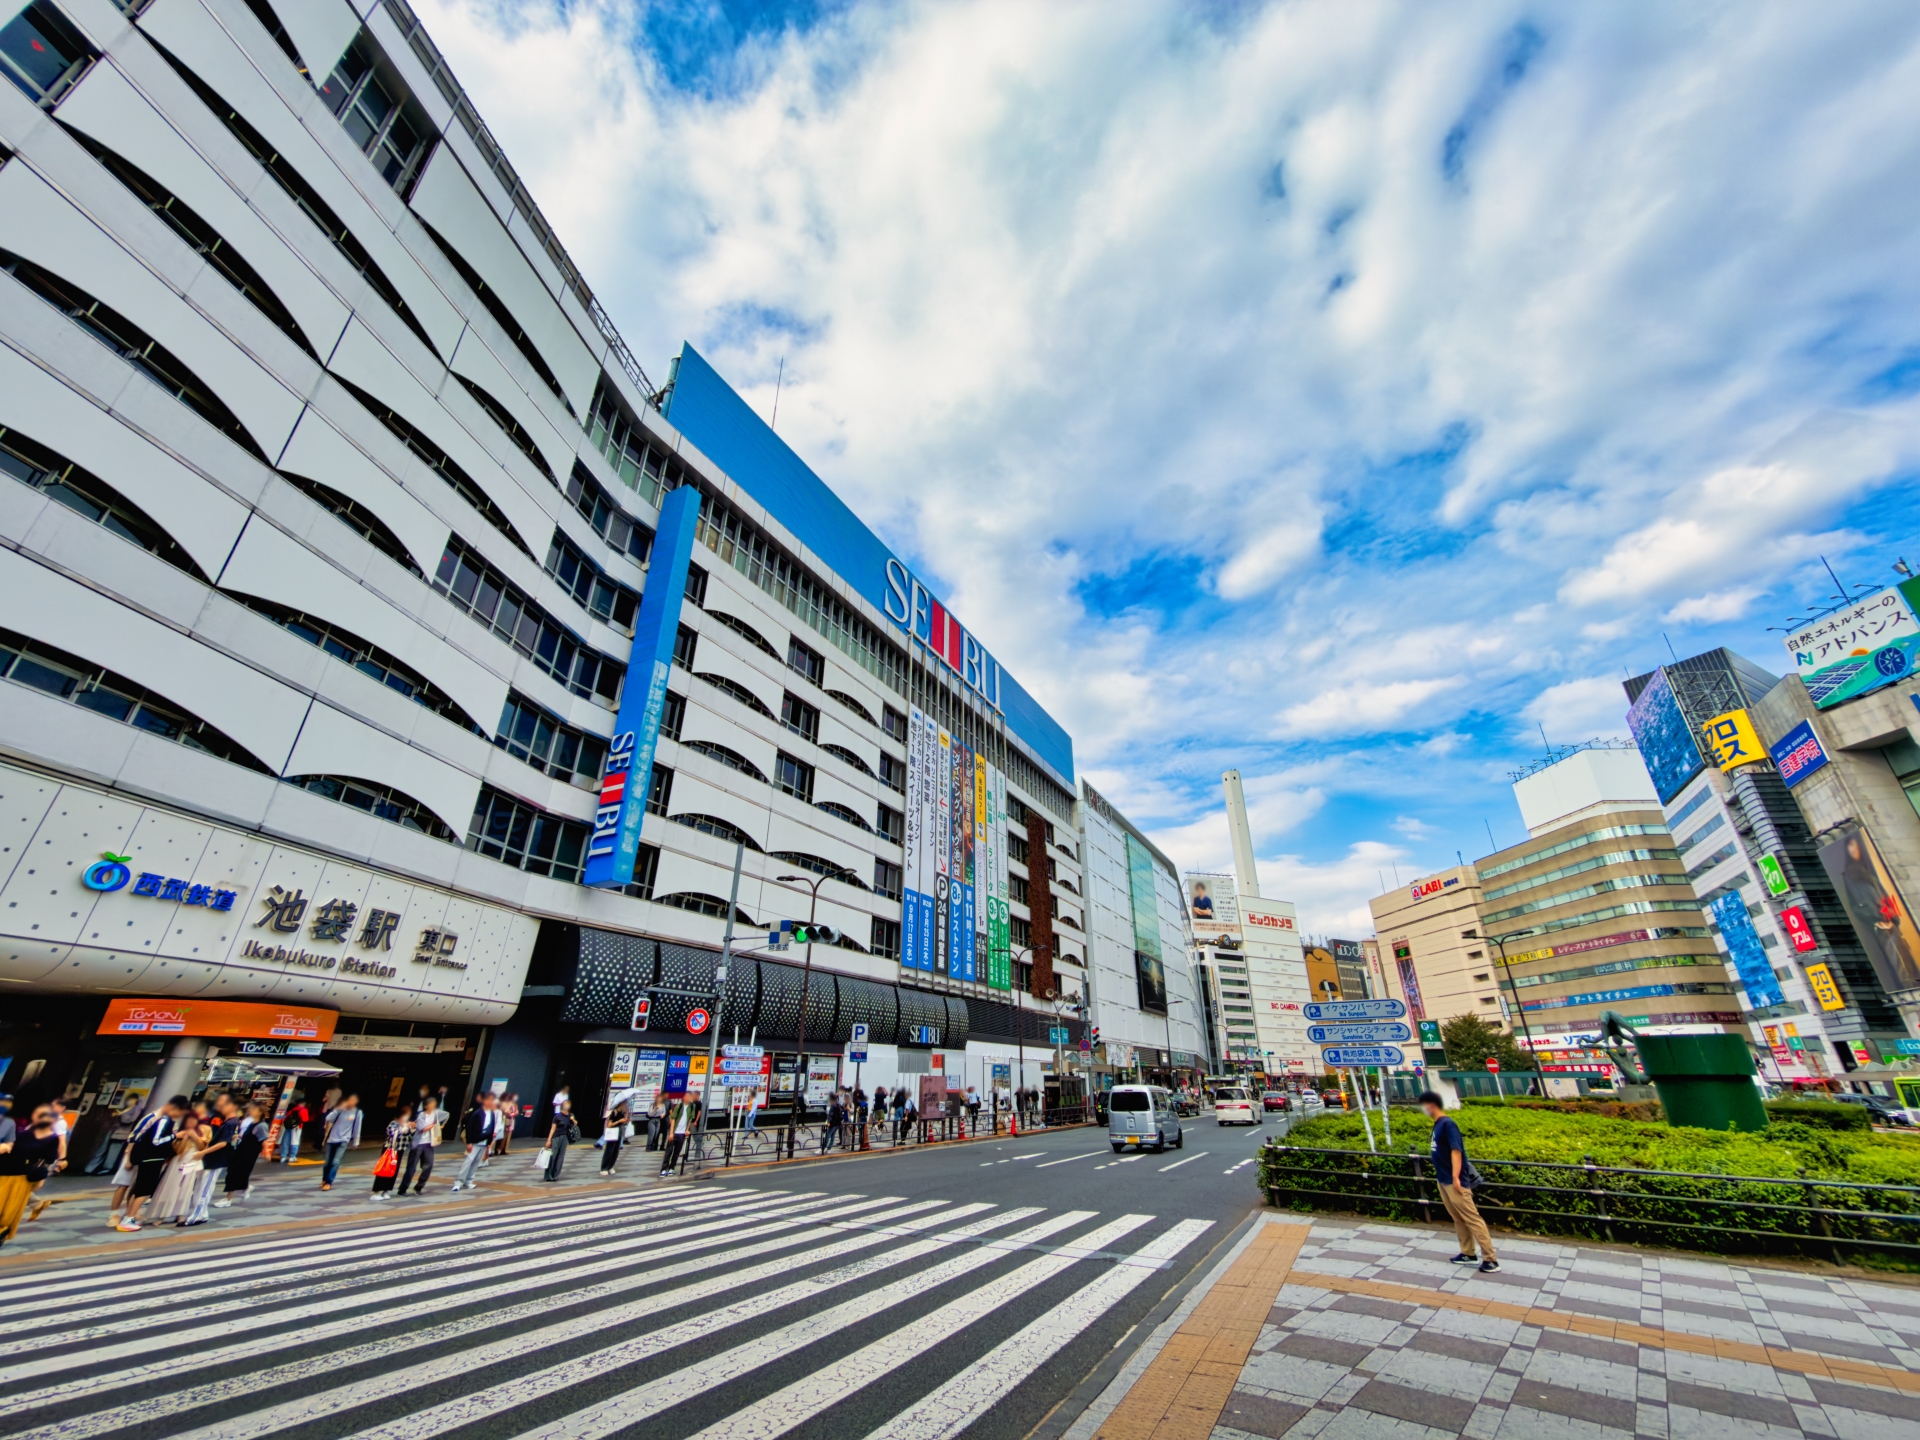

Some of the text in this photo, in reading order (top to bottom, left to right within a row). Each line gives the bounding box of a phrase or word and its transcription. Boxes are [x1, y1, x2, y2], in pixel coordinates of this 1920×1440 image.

[1787, 595, 1896, 652] 自然エネルギーの
[884, 557, 1000, 711] SEIBU
[1815, 610, 1908, 659] アドバンス
[1778, 738, 1821, 779] 日建学院
[586, 730, 634, 861] SEIBU
[132, 871, 237, 911] 西武鉄道
[1419, 878, 1443, 897] LABI
[254, 884, 402, 951] 池袋駅
[1248, 913, 1293, 929] ビックカメラ
[421, 929, 458, 955] 東口
[952, 907, 960, 972] レストラン
[1557, 937, 1619, 954] レディースアートネイチャー
[1791, 930, 1811, 945] アコム
[241, 940, 397, 978] Ikebukuro Station
[1573, 990, 1639, 1003] アートネイチャー
[1271, 1002, 1299, 1011] BIC CAMERA
[1324, 1003, 1381, 1011] イケ・サンパーク
[854, 1025, 865, 1040] P
[909, 1026, 940, 1045] SEIBU
[1327, 1026, 1387, 1034] サンシャインシティ
[1342, 1049, 1380, 1057] 南池袋公園
[669, 1060, 688, 1069] SEIBU
